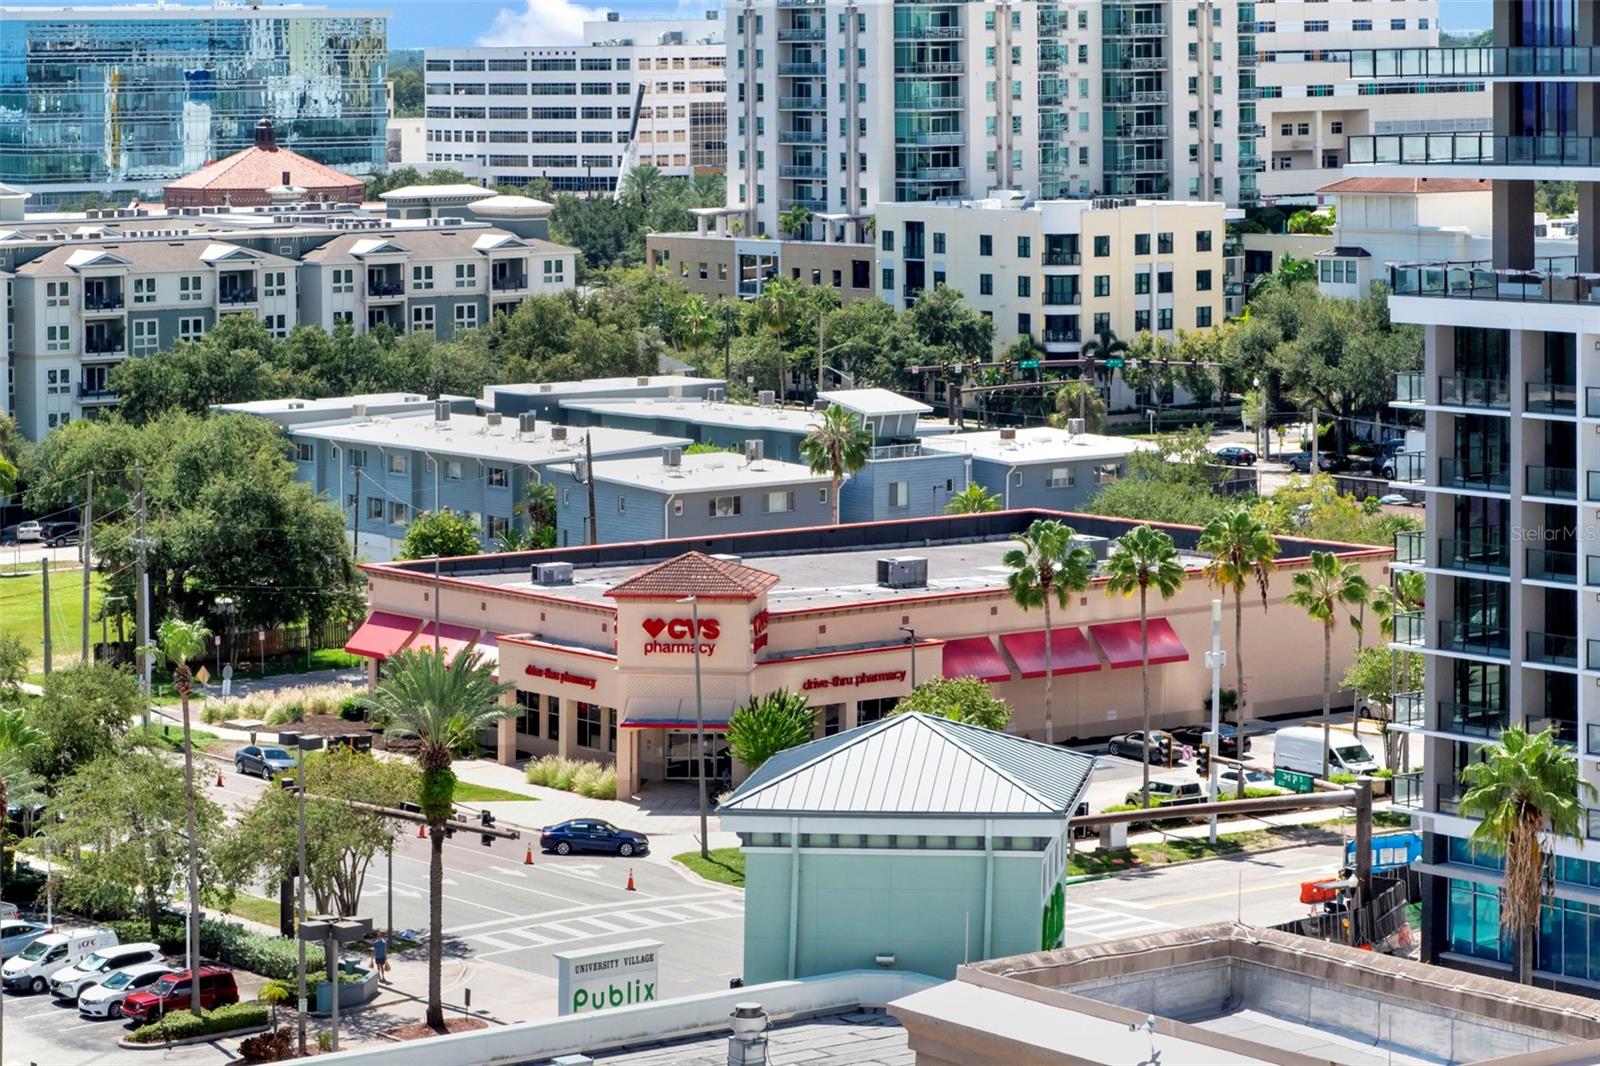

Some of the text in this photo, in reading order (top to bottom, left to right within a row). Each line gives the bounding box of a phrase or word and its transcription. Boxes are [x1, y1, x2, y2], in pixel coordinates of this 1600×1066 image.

[667, 618, 720, 640] CVS
[644, 640, 716, 656] pharmacy
[803, 670, 907, 690] drive-thru pharmacy
[575, 953, 655, 974] UNIVERSITY VILLAGE
[573, 979, 655, 1013] Publix
